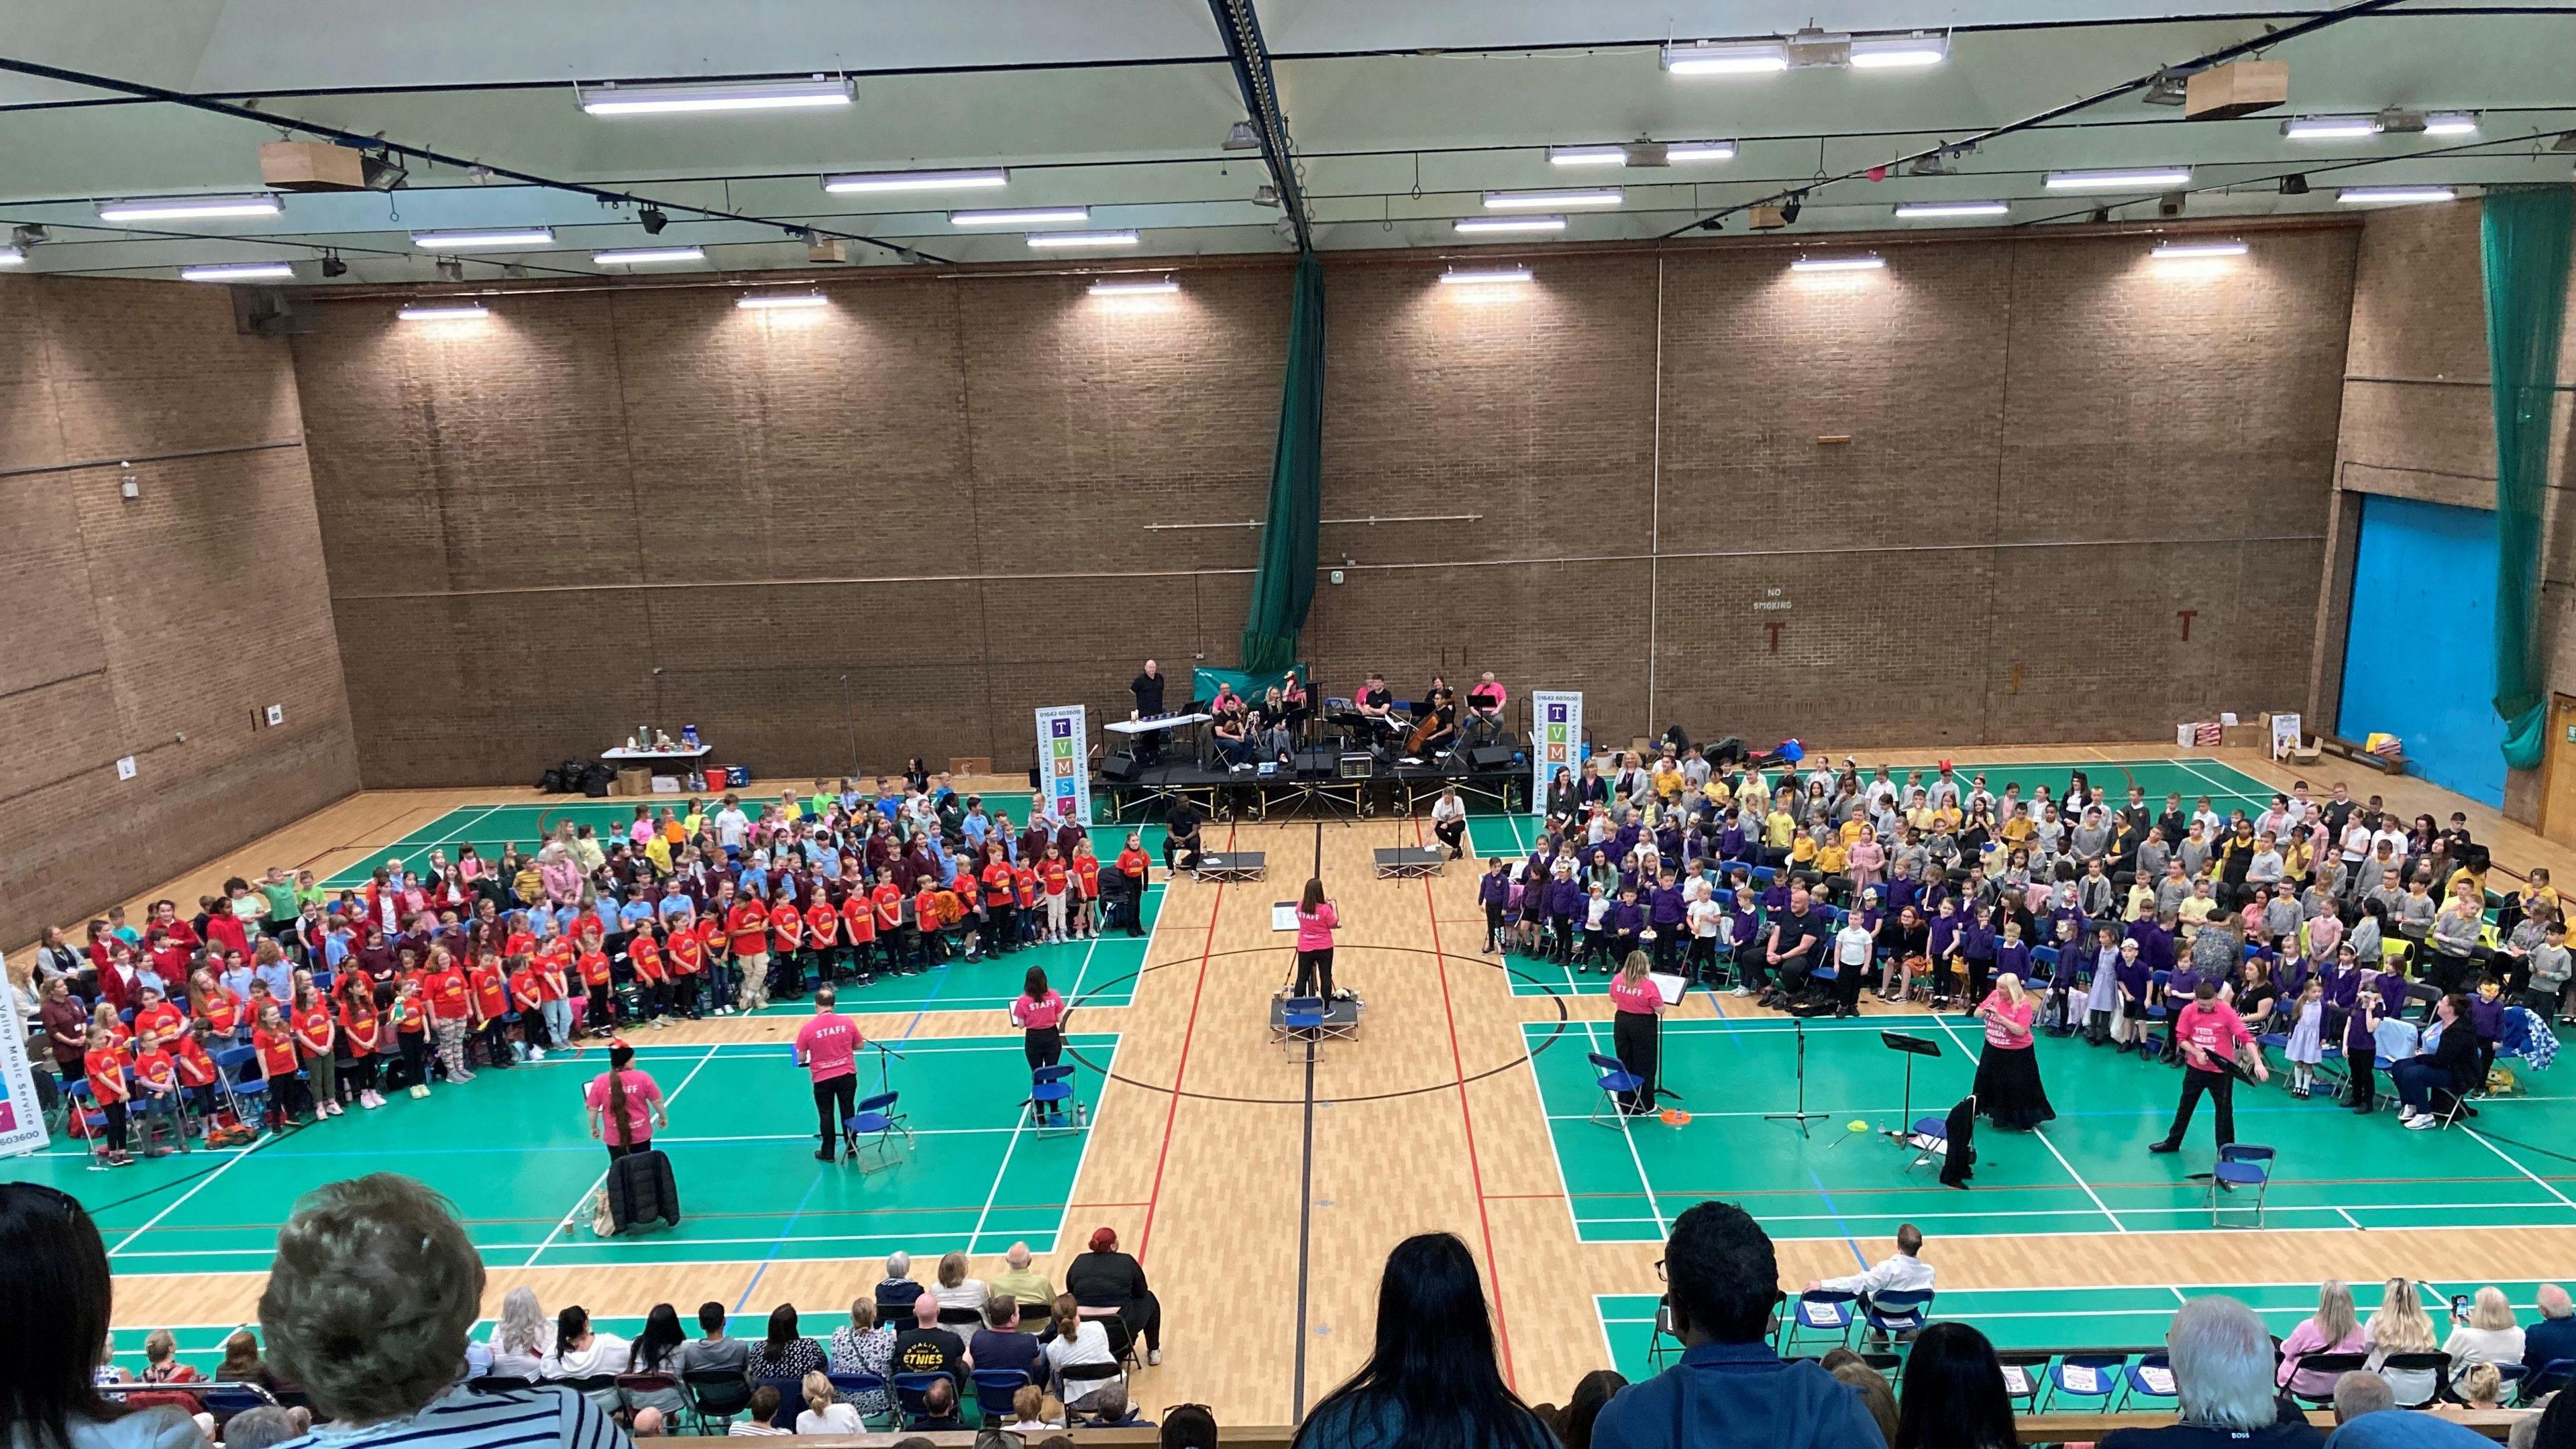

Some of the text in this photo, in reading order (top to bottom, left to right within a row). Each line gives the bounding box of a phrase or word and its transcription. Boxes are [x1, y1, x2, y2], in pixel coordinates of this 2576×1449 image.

[1754, 601, 1792, 610] SMOKING
[1298, 911, 1320, 921] STAFF
[1616, 984, 1643, 997] STAFF
[1029, 999, 1056, 1011] STAFF
[816, 1025, 847, 1038] STAFF
[0, 1004, 34, 1125] Valley Music Service
[907, 1342, 940, 1354] QUALITY
[903, 1354, 943, 1364] ETNIES
